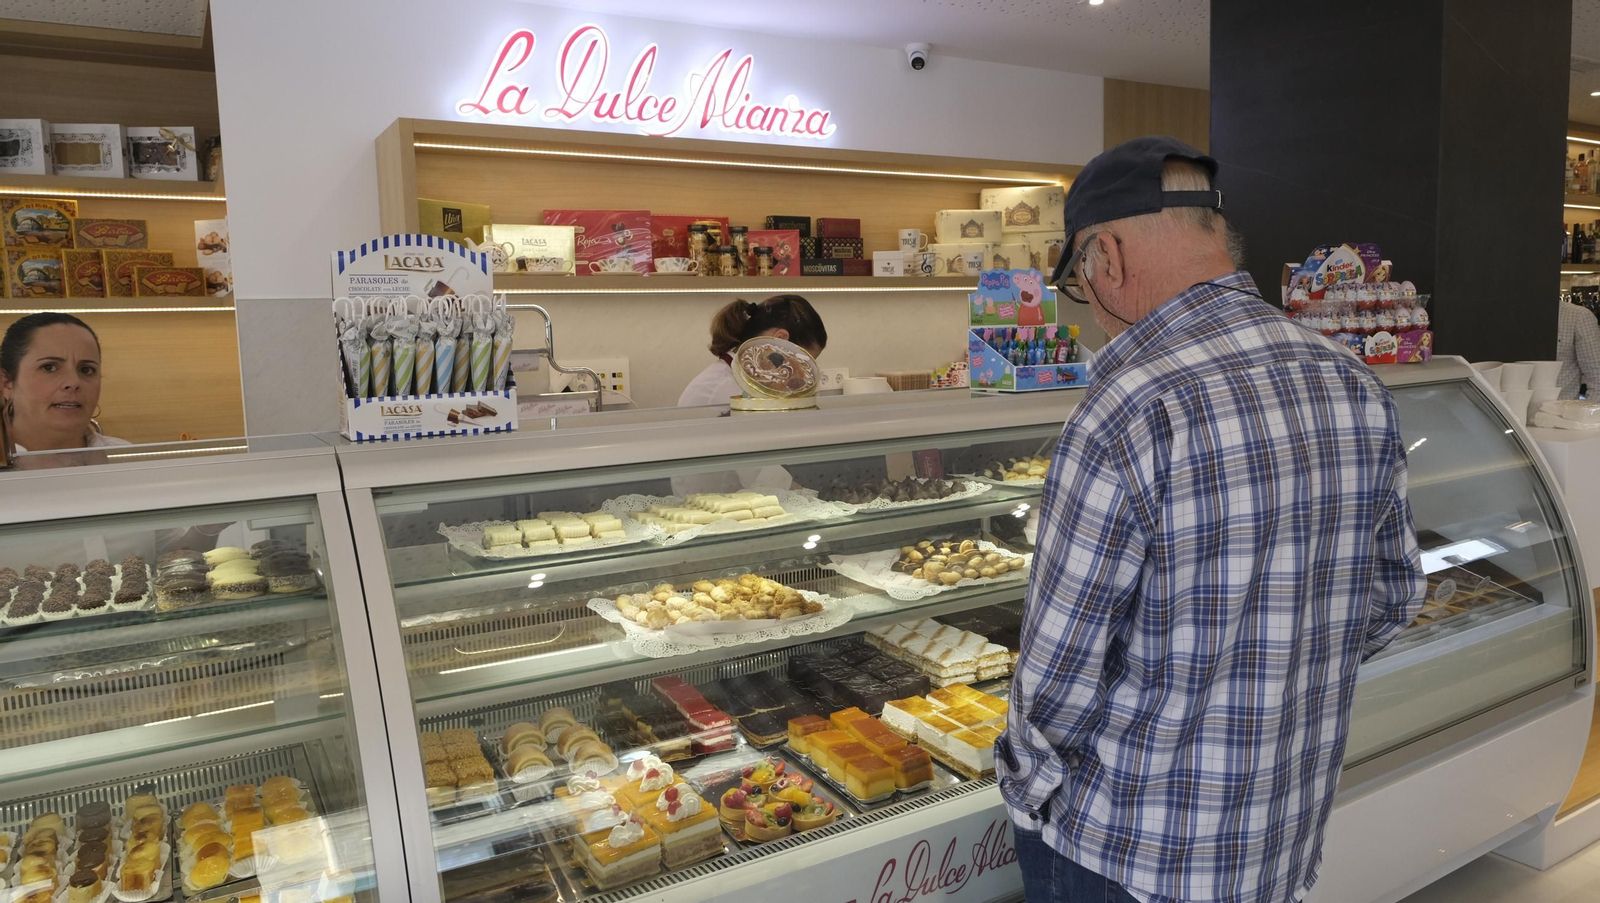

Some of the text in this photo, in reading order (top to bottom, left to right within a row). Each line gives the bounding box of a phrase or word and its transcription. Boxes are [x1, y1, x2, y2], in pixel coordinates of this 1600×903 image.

[459, 25, 835, 137] La Dulce Alianza
[522, 238, 547, 246] LACASA
[384, 254, 445, 273] LACASA
[350, 277, 399, 285] PARASOLES
[982, 274, 1010, 288] Peppa Pig
[380, 404, 422, 417] LACASA
[870, 819, 1019, 903] La Dulce Alia
